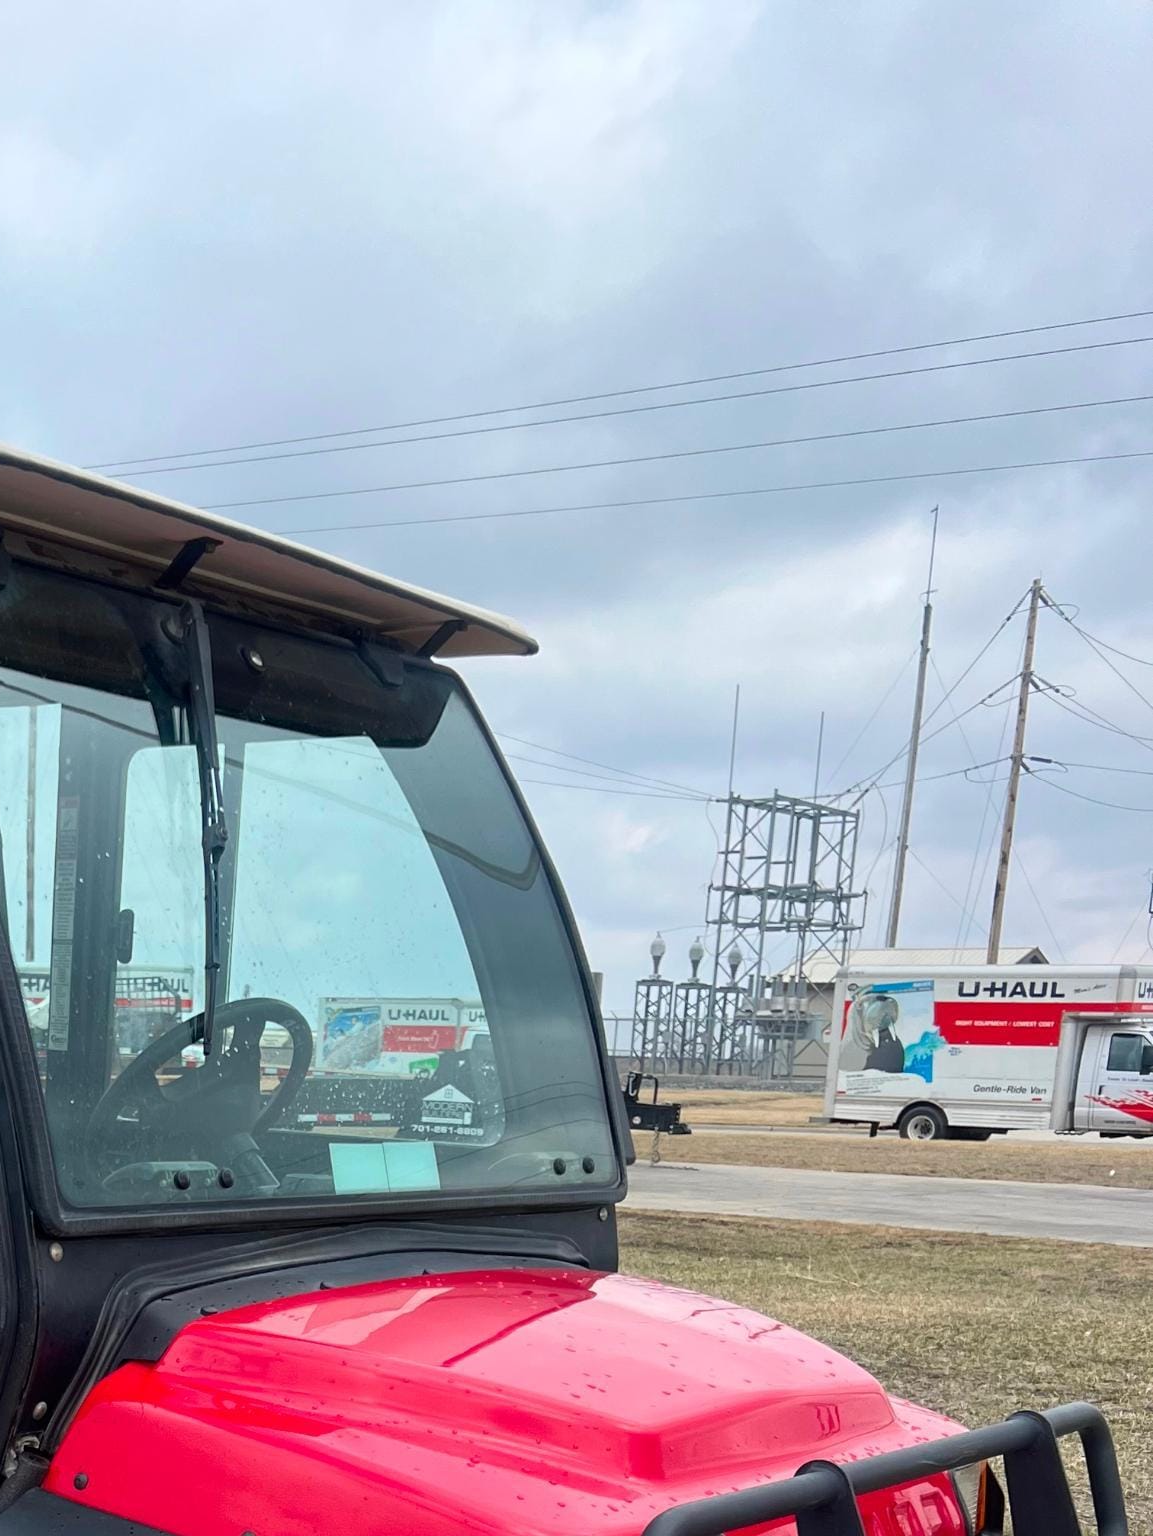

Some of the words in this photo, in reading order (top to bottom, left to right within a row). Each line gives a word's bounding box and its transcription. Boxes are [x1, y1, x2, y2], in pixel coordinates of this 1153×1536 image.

[958, 981, 1065, 998] U-HAUL
[388, 1008, 449, 1021] U-HAUL
[973, 1084, 1027, 1094] Gentle-Ride
[1030, 1086, 1047, 1094] Van
[420, 1101, 473, 1112] MODERN
